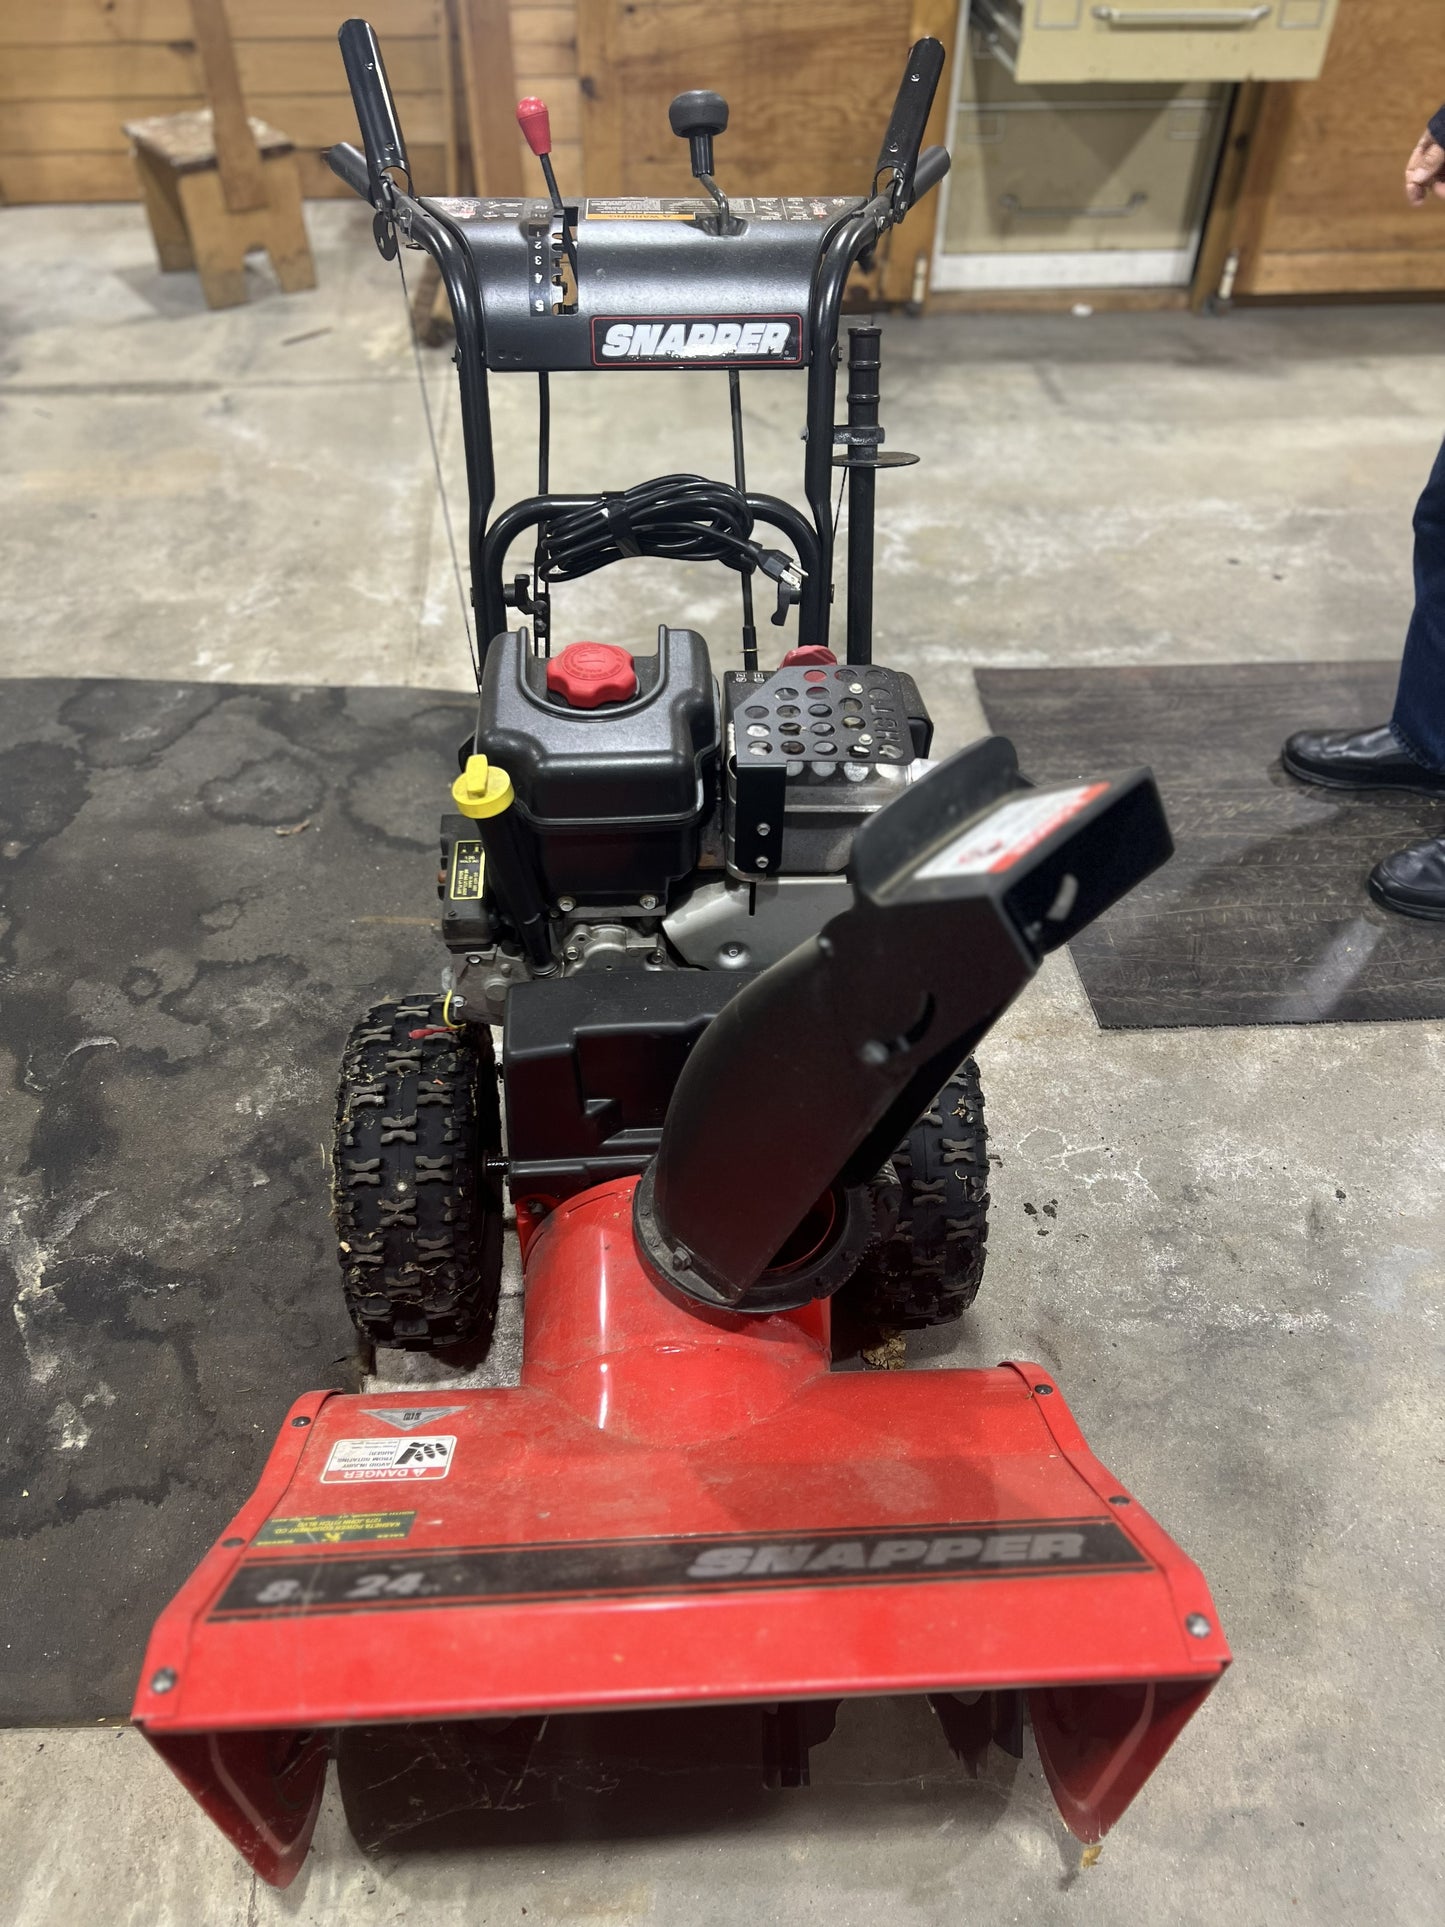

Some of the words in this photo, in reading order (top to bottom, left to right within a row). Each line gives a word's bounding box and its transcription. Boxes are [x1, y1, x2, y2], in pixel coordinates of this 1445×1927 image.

[534, 241, 542, 249] 2
[534, 256, 542, 265] 3
[534, 273, 543, 284] 4
[535, 301, 544, 312] 5
[602, 322, 791, 358] SNAPPER
[343, 1468, 409, 1479] DANGER
[687, 1532, 1086, 1578] SNAPPER
